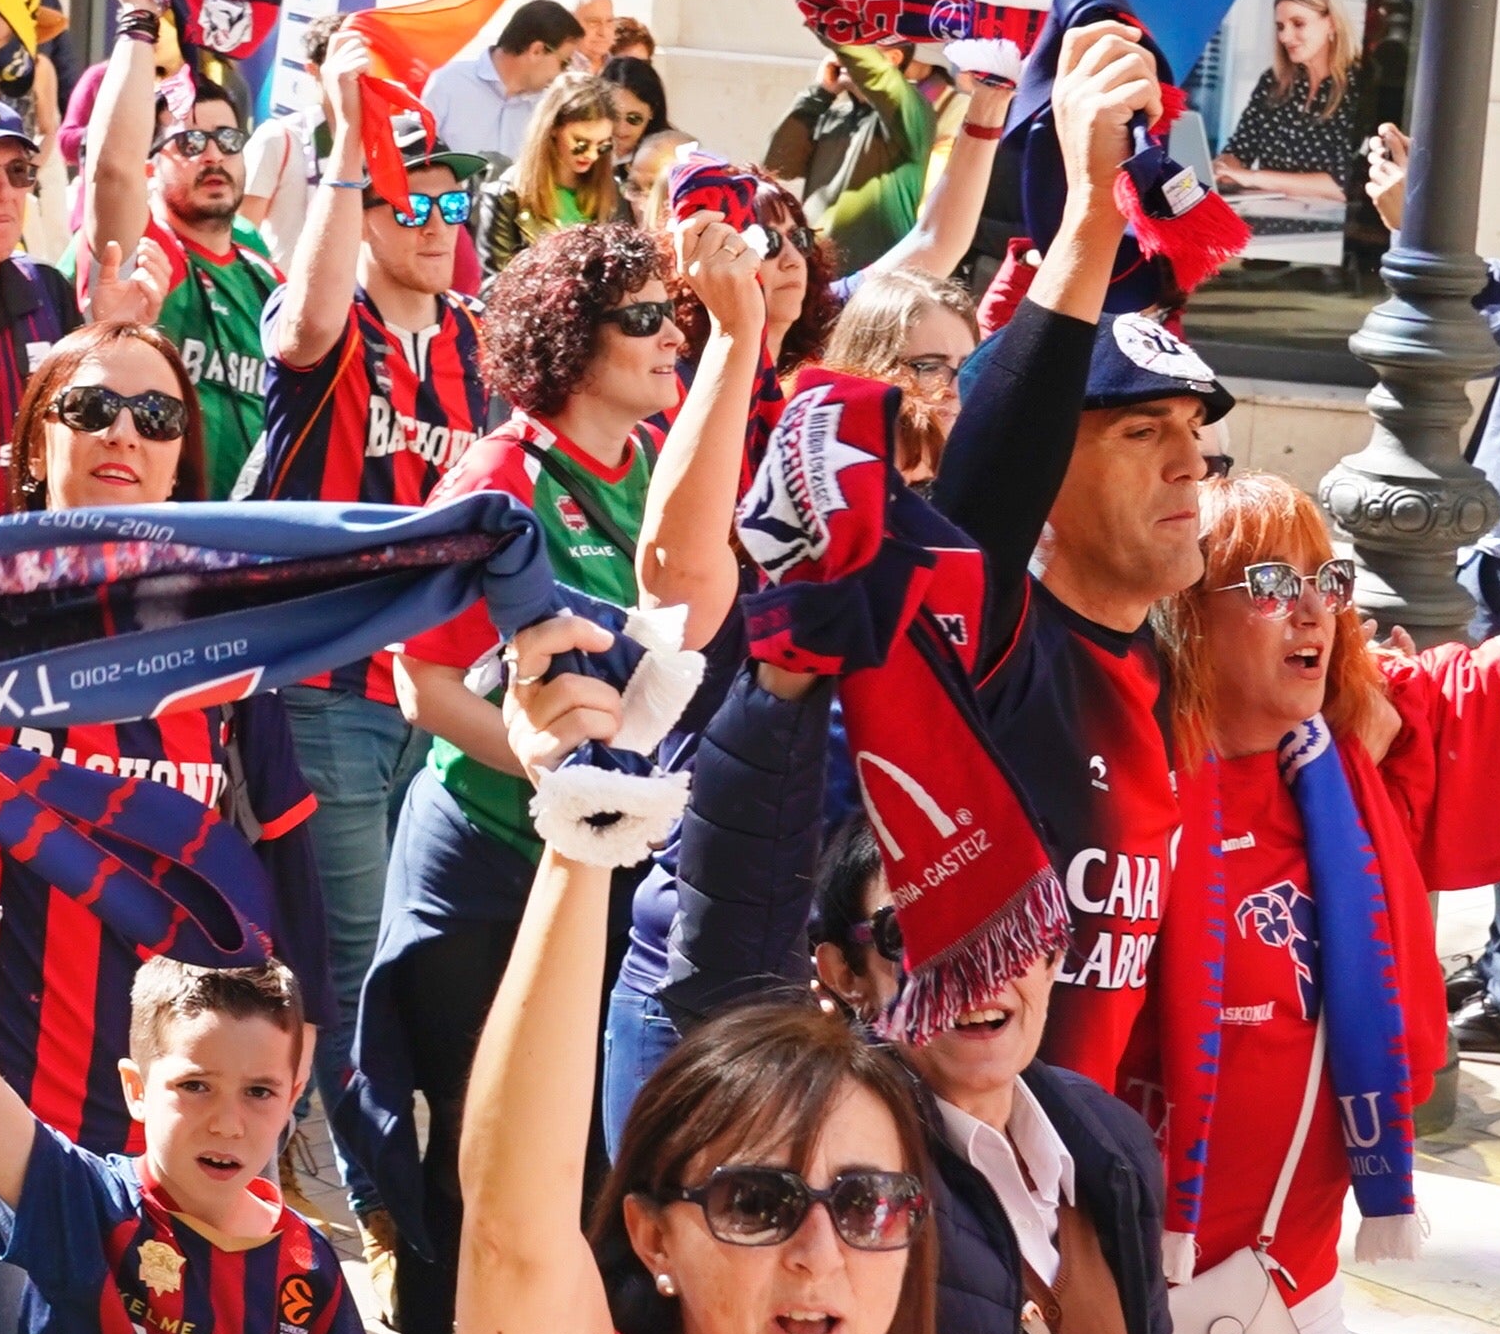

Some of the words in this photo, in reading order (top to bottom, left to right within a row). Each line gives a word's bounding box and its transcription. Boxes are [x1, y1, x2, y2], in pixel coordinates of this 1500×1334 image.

[70, 648, 196, 690] 2009-2010
[203, 638, 248, 661] acb
[1065, 847, 1161, 924] CAJA
